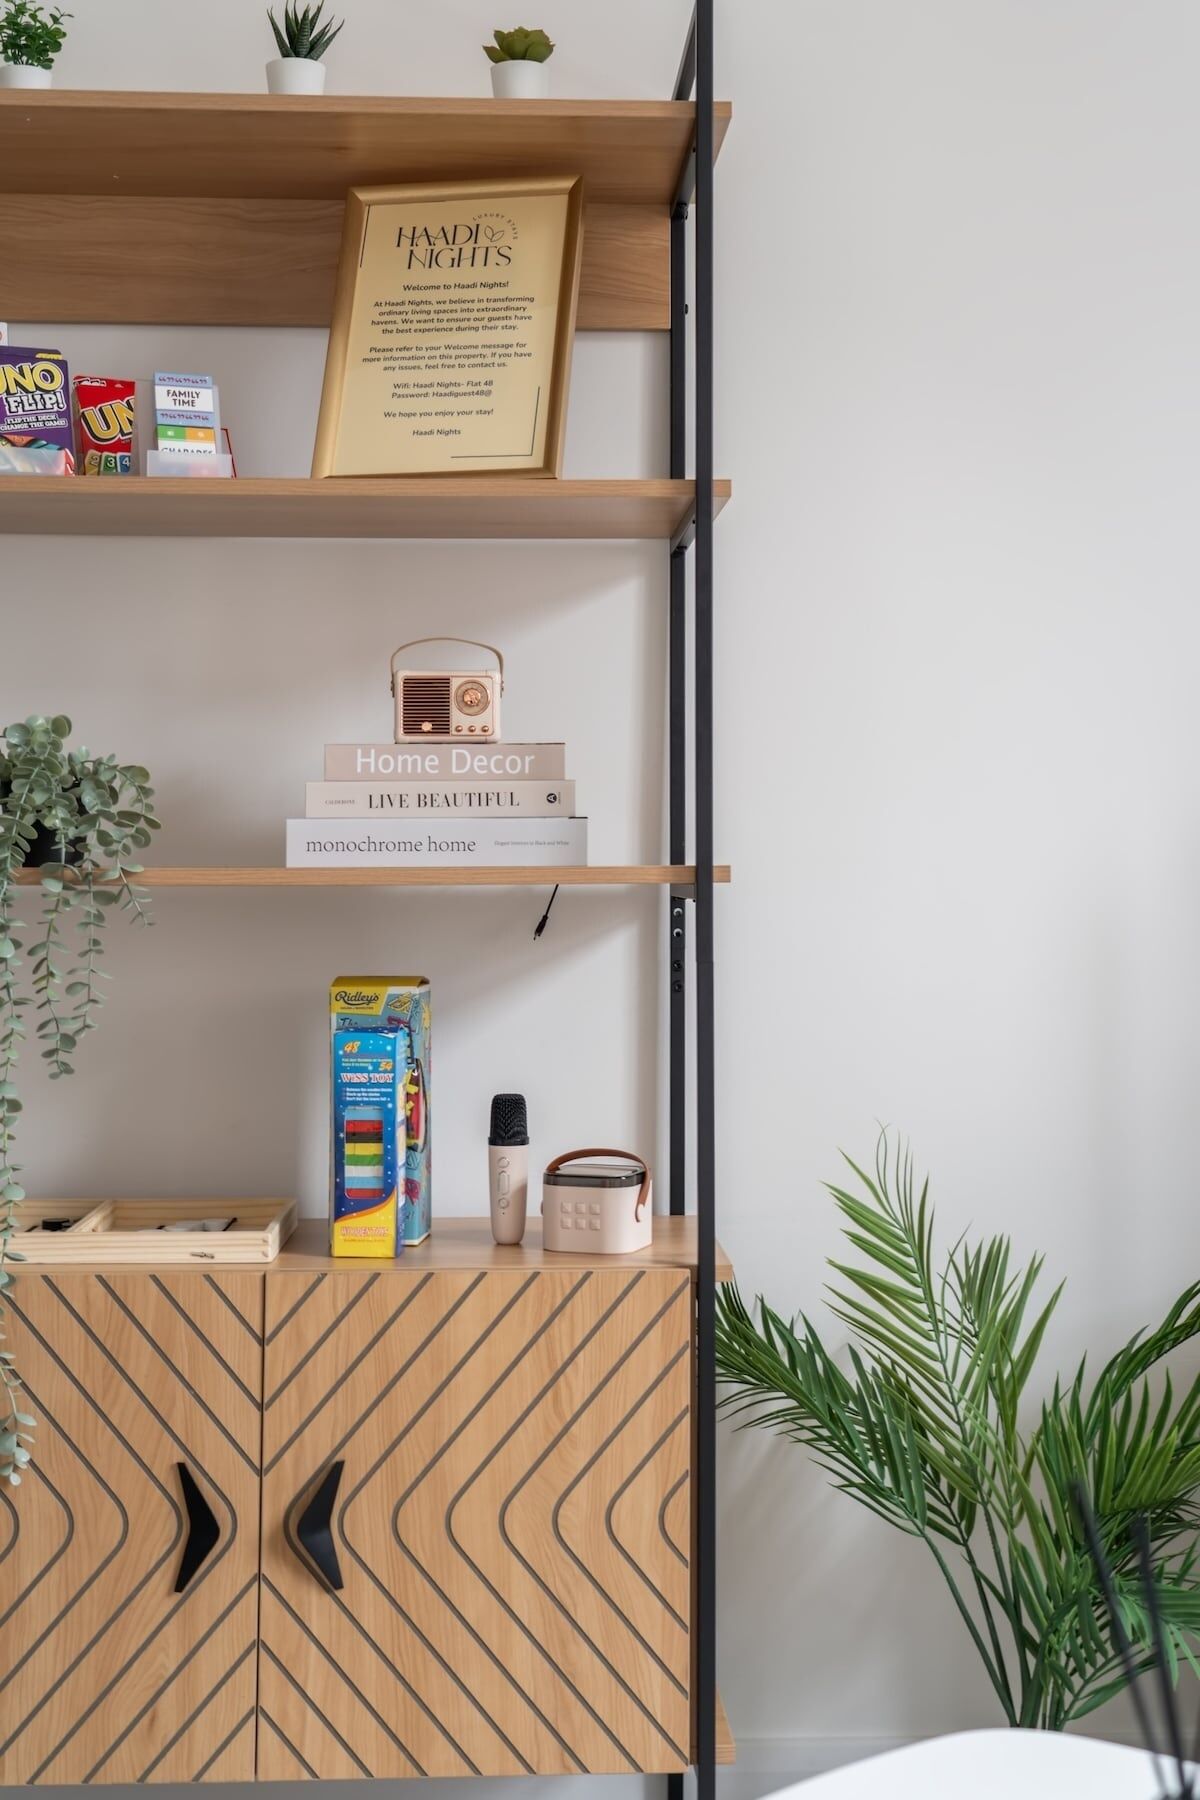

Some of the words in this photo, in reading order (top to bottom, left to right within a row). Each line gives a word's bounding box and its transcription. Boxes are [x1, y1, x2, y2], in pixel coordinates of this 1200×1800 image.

[397, 224, 480, 247] HAADI
[408, 246, 512, 269] NIGHTS
[403, 284, 441, 292] Welcome
[480, 281, 509, 291] Nights!
[408, 299, 433, 307] Nights,
[449, 297, 475, 305] believe
[487, 296, 534, 305] transforming
[379, 309, 409, 317] ordinary
[476, 305, 527, 313] extraordinary
[455, 325, 480, 333] during
[437, 381, 464, 390] Nights-
[167, 389, 201, 399] FAMILY
[7, 390, 64, 413] FLIP!
[172, 398, 196, 407] TIME
[399, 411, 417, 419] hope
[435, 409, 455, 417] enjoy
[29, 421, 45, 429] THE
[437, 428, 461, 436] Nights
[107, 457, 115, 467] 3
[355, 748, 440, 774] Home
[451, 749, 535, 774] Decor
[368, 793, 410, 809] LIVE
[417, 791, 520, 808] BEAUTIFUL
[306, 835, 423, 853] monochrome
[427, 836, 476, 853] home
[335, 990, 380, 1006] Ridley's
